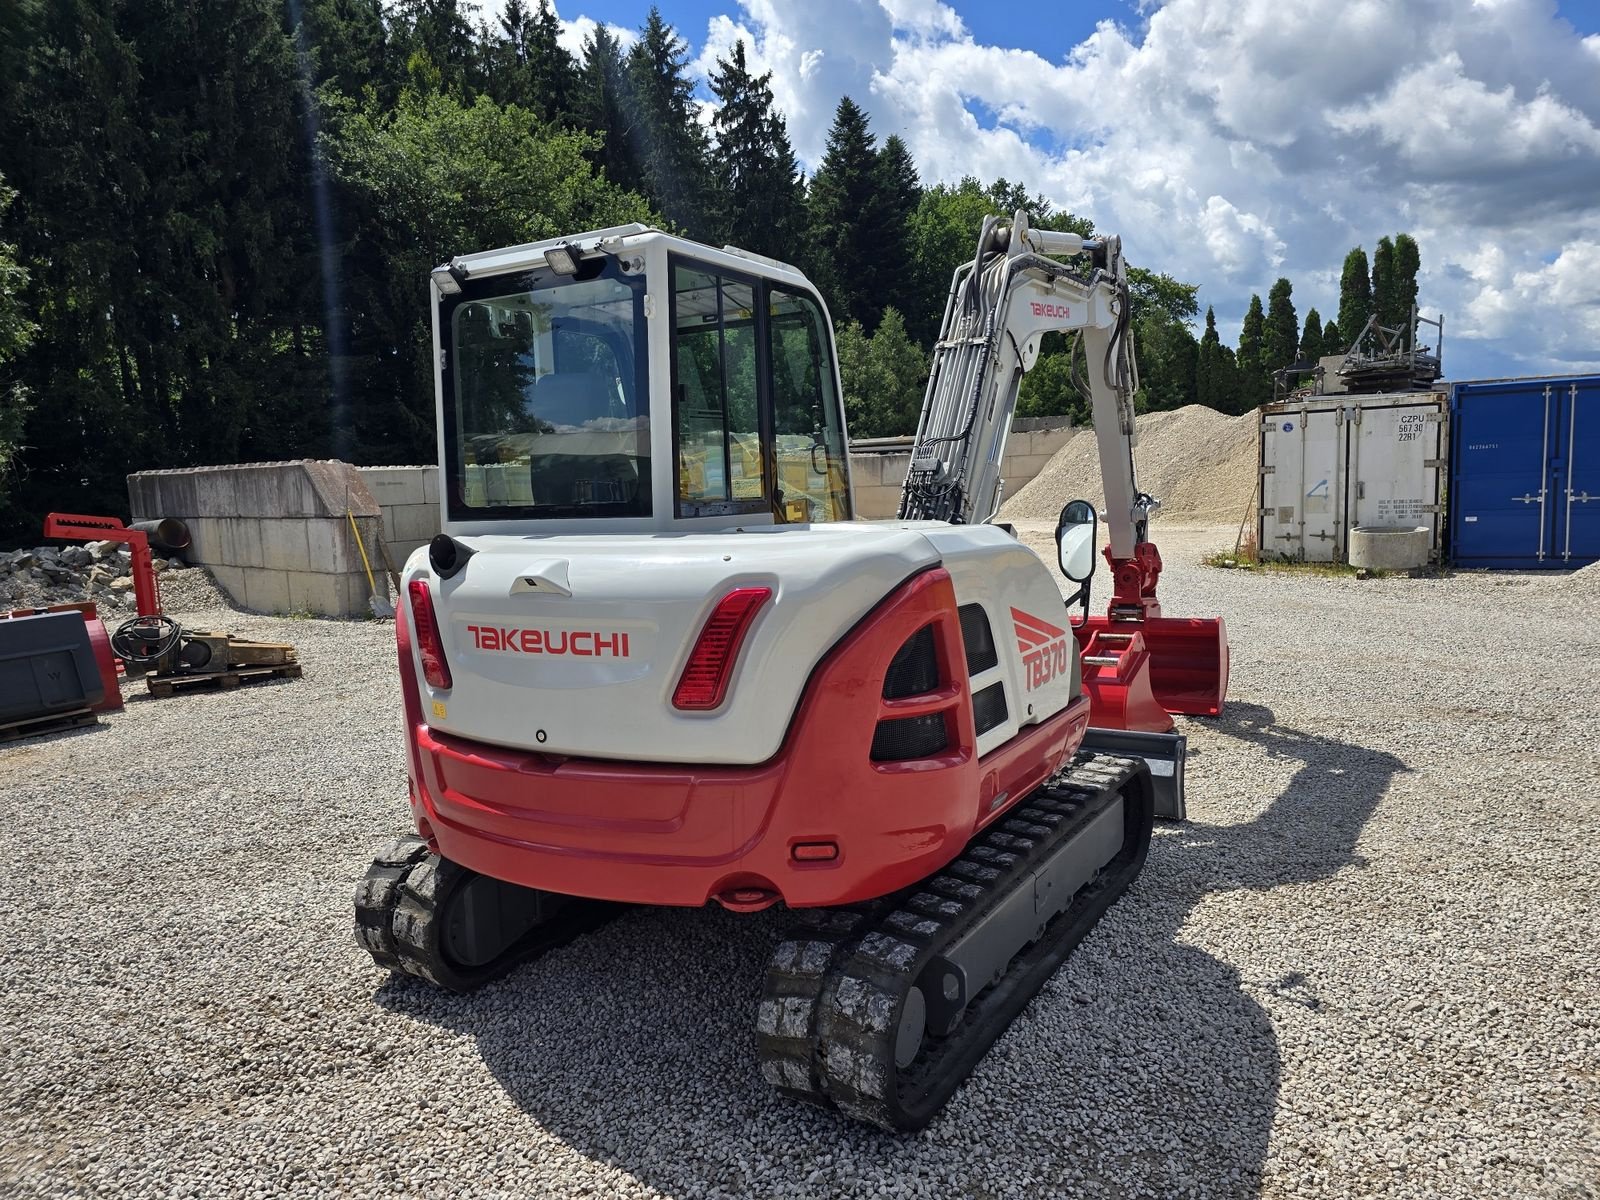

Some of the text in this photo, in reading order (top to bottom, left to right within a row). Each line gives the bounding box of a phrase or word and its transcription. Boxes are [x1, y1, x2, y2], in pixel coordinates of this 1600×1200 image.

[1030, 302, 1070, 319] TAKEUCHI
[1401, 414, 1424, 423] CZPU
[1398, 432, 1416, 441] 22R1
[467, 625, 629, 657] TAKEUCHI
[1022, 639, 1067, 693] TB370
